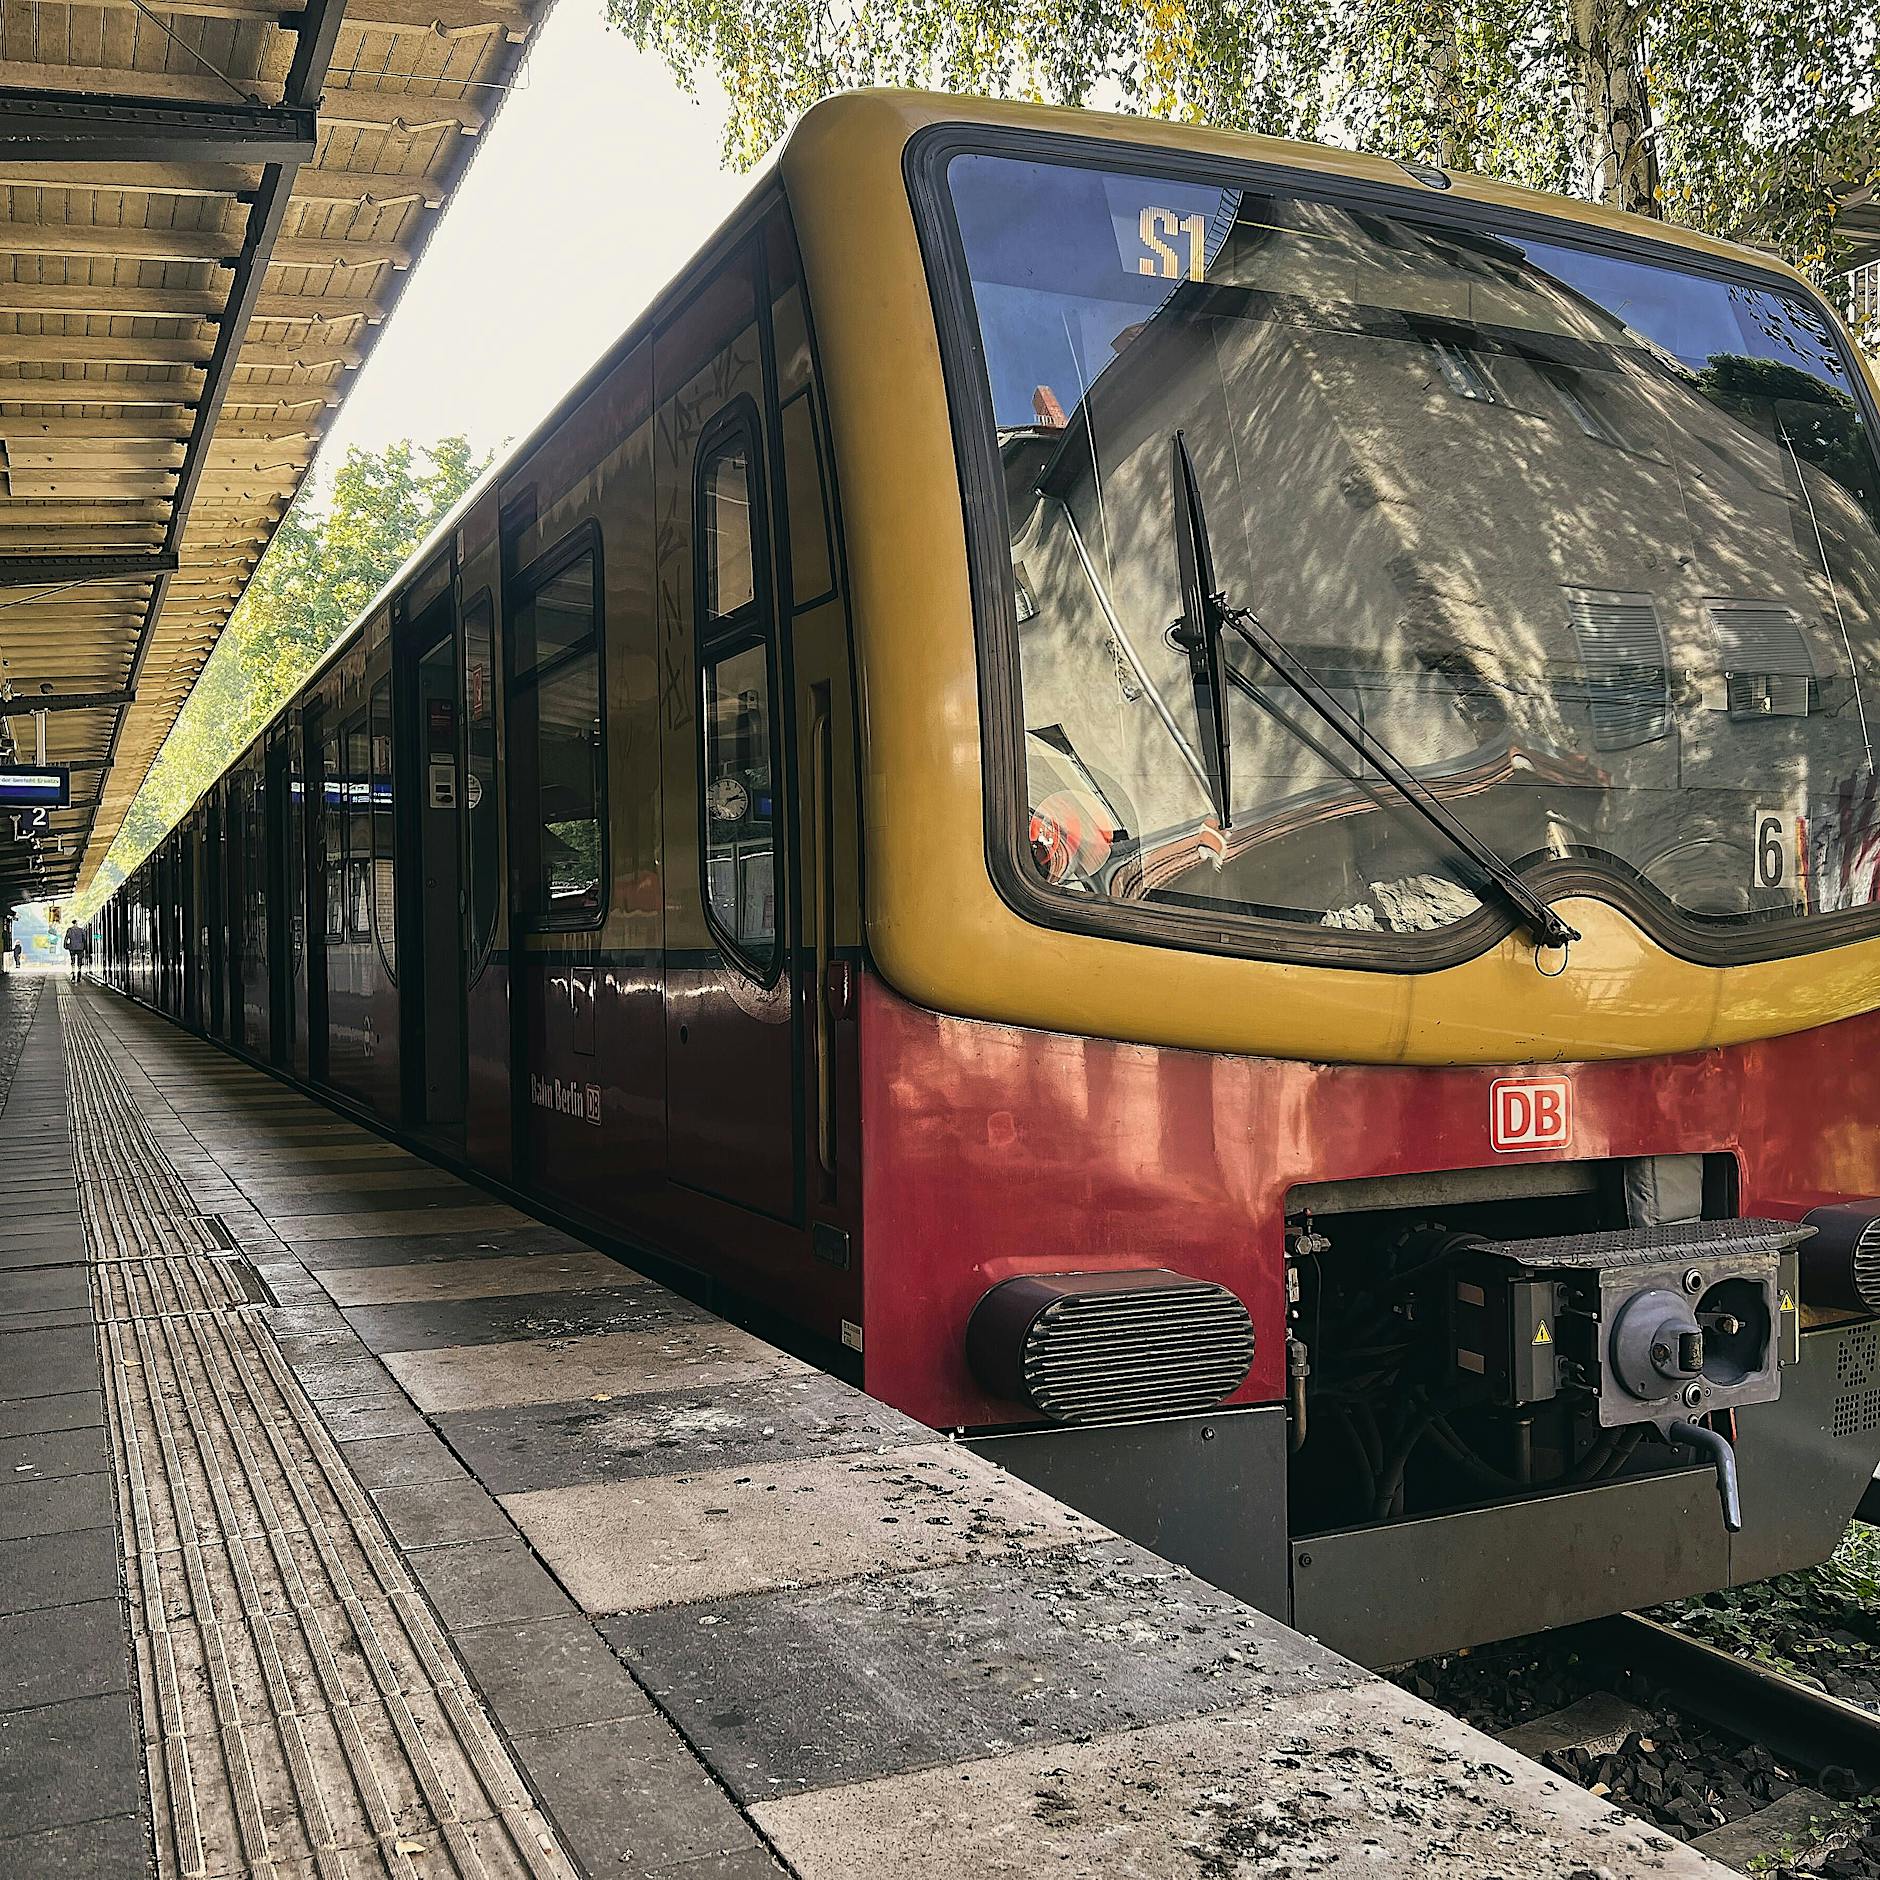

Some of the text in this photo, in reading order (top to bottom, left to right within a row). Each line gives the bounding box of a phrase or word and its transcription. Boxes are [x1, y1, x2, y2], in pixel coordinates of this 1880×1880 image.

[1139, 206, 1205, 283] S1
[32, 807, 47, 826] 2
[1759, 817, 1783, 888] 6
[531, 1073, 553, 1109] Bahn
[555, 1078, 584, 1118] Berlin
[1501, 1088, 1563, 1140] DB
